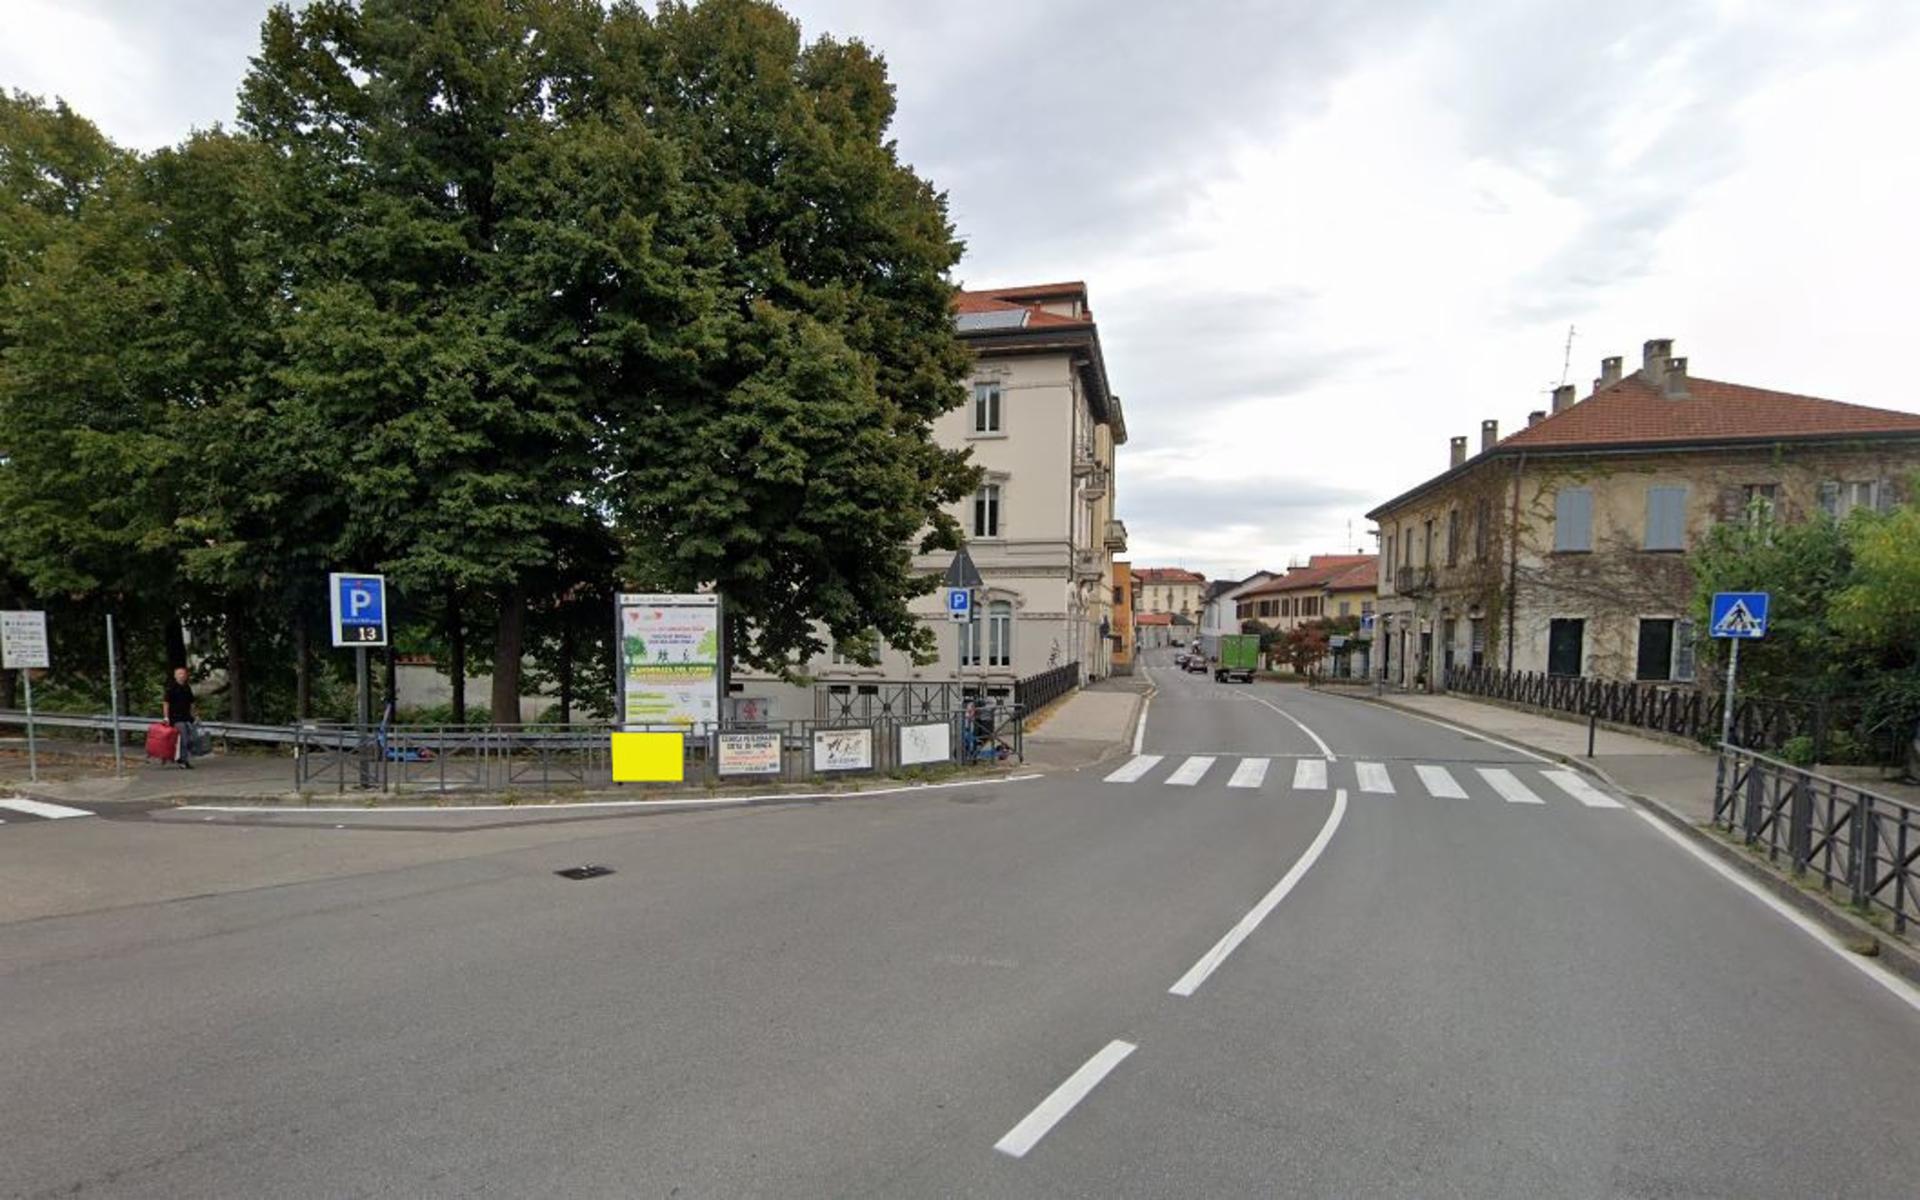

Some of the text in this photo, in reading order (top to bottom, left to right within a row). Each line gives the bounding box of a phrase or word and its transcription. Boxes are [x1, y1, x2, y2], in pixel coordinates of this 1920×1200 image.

[351, 590, 371, 617] P
[954, 594, 964, 608] P
[359, 627, 376, 641] 13
